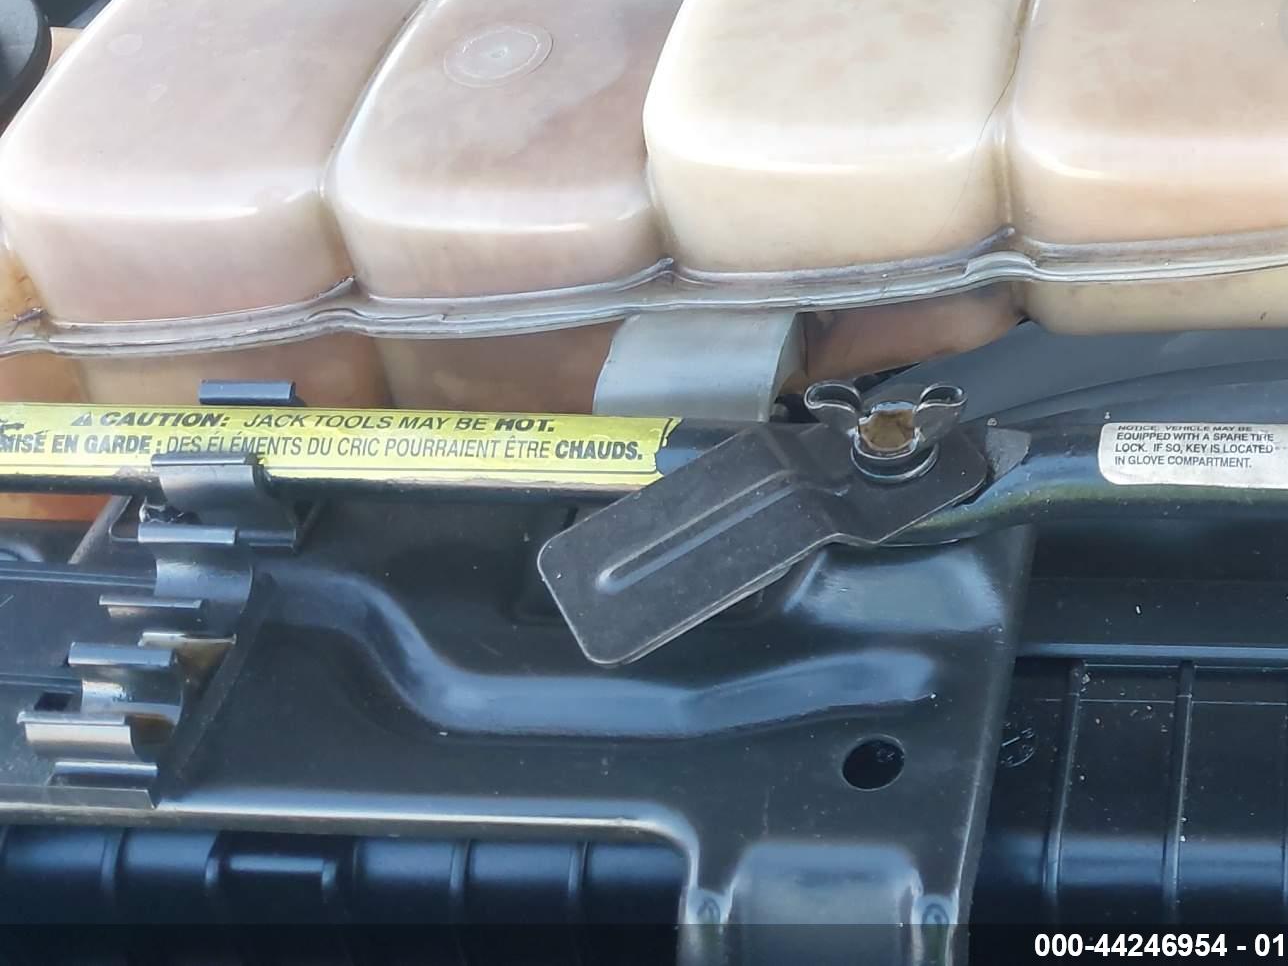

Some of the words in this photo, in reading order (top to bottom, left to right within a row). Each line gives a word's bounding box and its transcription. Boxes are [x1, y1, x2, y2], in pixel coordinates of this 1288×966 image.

[100, 412, 231, 427] CAUTION:
[244, 414, 309, 428] JACK
[315, 415, 393, 429] TOOLS
[400, 417, 450, 430] MAY
[455, 418, 487, 431] BE
[494, 418, 555, 432] HOT.
[1116, 432, 1171, 441] EQUIPPED
[1174, 433, 1200, 441] WITH
[1203, 433, 1210, 441] A
[1213, 433, 1249, 442] SPARE
[52, 434, 80, 453] EN
[167, 436, 202, 454] DES
[206, 431, 303, 455] ÉLÉMENTS
[307, 436, 334, 455] DU
[337, 437, 380, 456] CRIC
[384, 437, 502, 457] POURRAIENT
[504, 435, 551, 459] ÊTRE
[555, 440, 643, 460] CHAUDS.
[1115, 443, 1148, 453] LOCK.
[1153, 444, 1164, 452] IF
[1165, 444, 1183, 454] SO,
[1186, 444, 1208, 453] KEY
[1210, 444, 1220, 453] IS
[1223, 444, 1274, 454] LOCATED
[1114, 456, 1125, 465] IN
[1128, 456, 1165, 465] GLOVE
[1167, 456, 1252, 468] COMPARTMENT.
